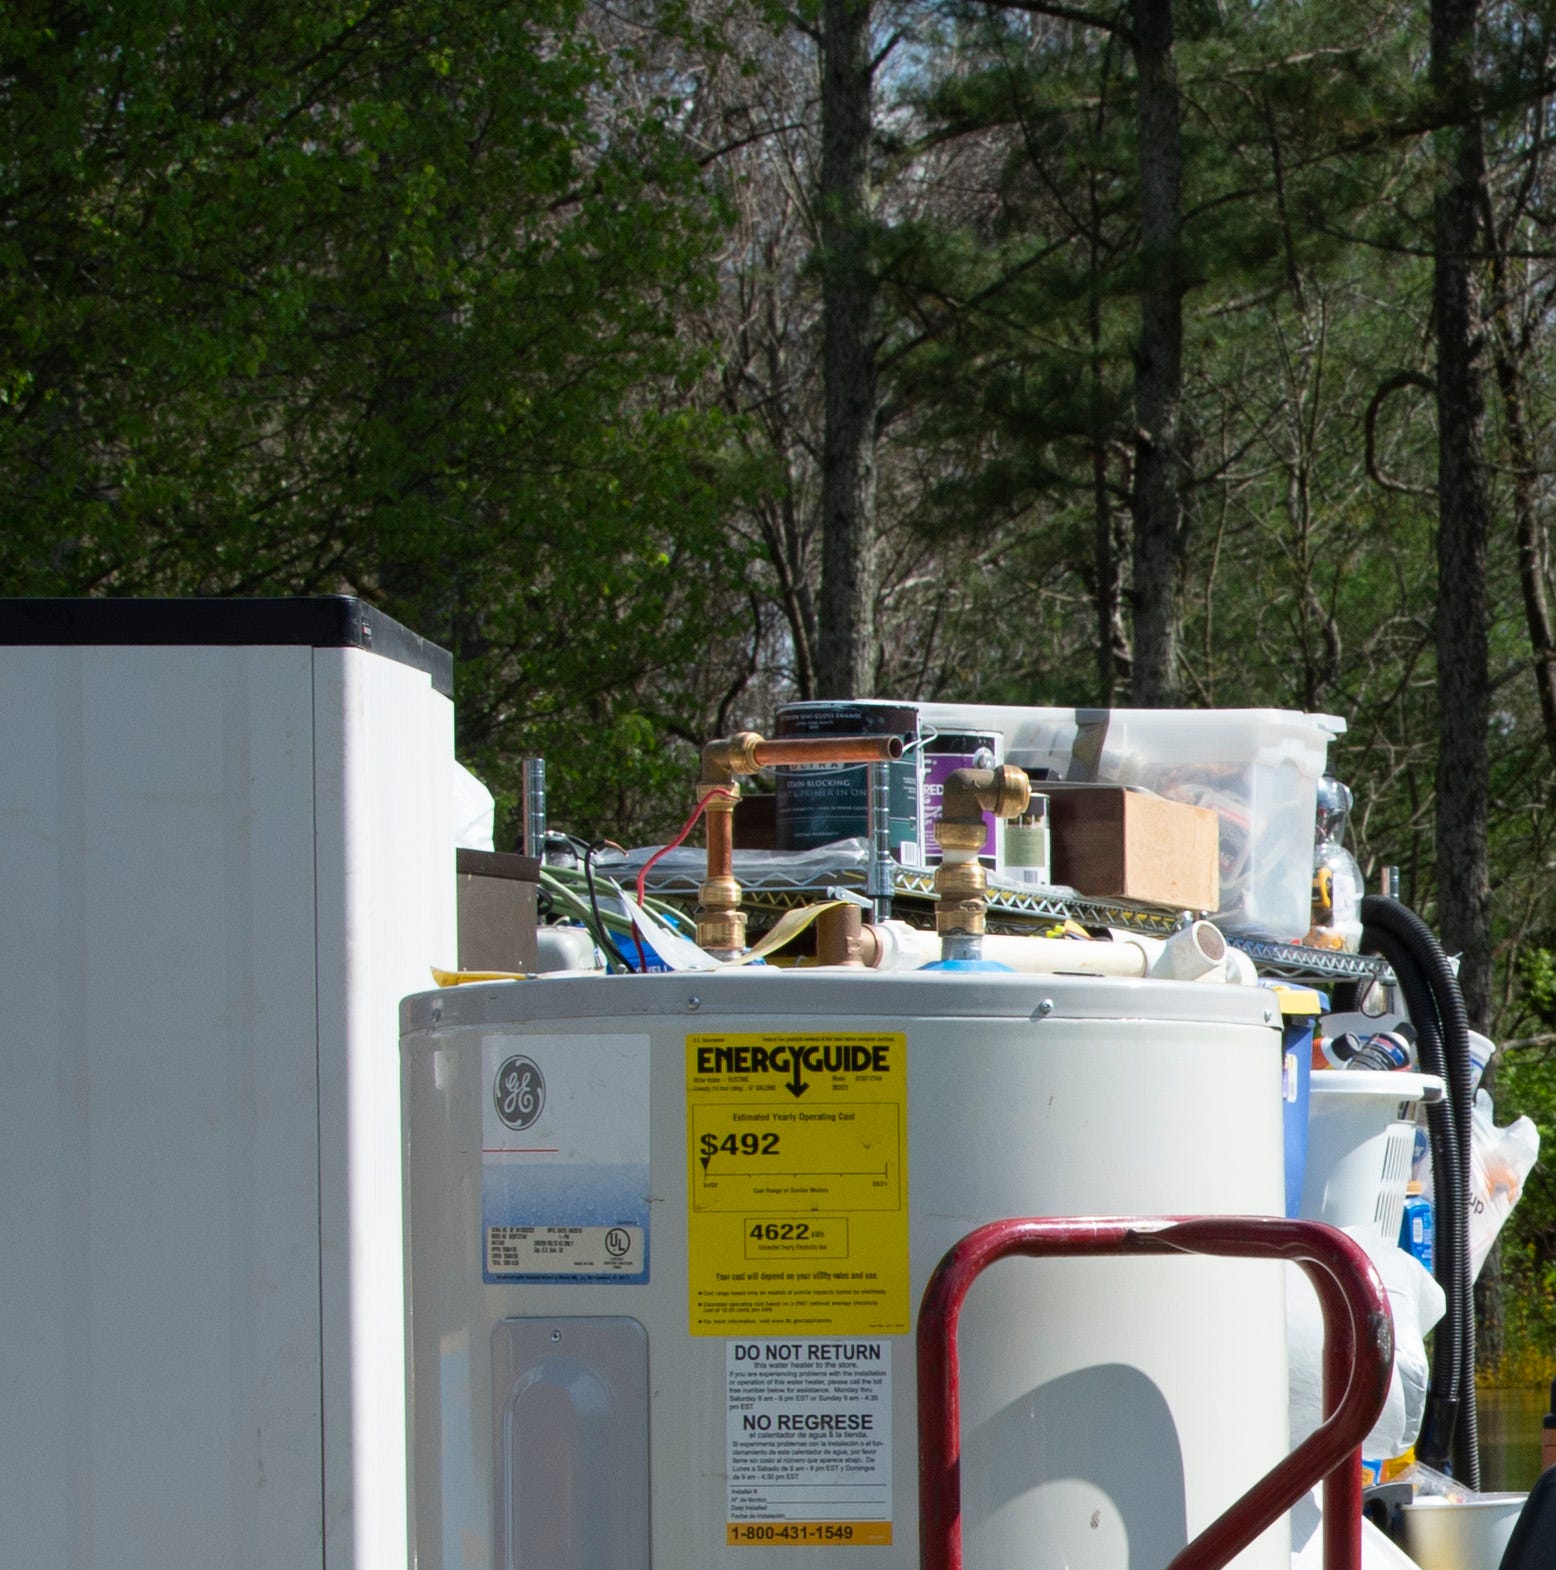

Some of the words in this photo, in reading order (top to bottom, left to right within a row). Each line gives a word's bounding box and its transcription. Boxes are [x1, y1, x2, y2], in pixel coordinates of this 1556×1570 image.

[697, 1045, 890, 1073] ENERGYGUIDE
[733, 1112, 770, 1121] Estimated
[772, 1112, 796, 1122] Yearly
[799, 1112, 836, 1122] Operating
[838, 1112, 855, 1121] Cost
[700, 1132, 780, 1156] $492
[749, 1223, 810, 1241] 4622
[734, 1344, 760, 1360] DO
[766, 1344, 803, 1360] NOT
[808, 1344, 881, 1360] RETURN
[743, 1414, 772, 1430] NO
[778, 1414, 874, 1430] REGRESE
[732, 1526, 853, 1540] 1-800-431-1549
